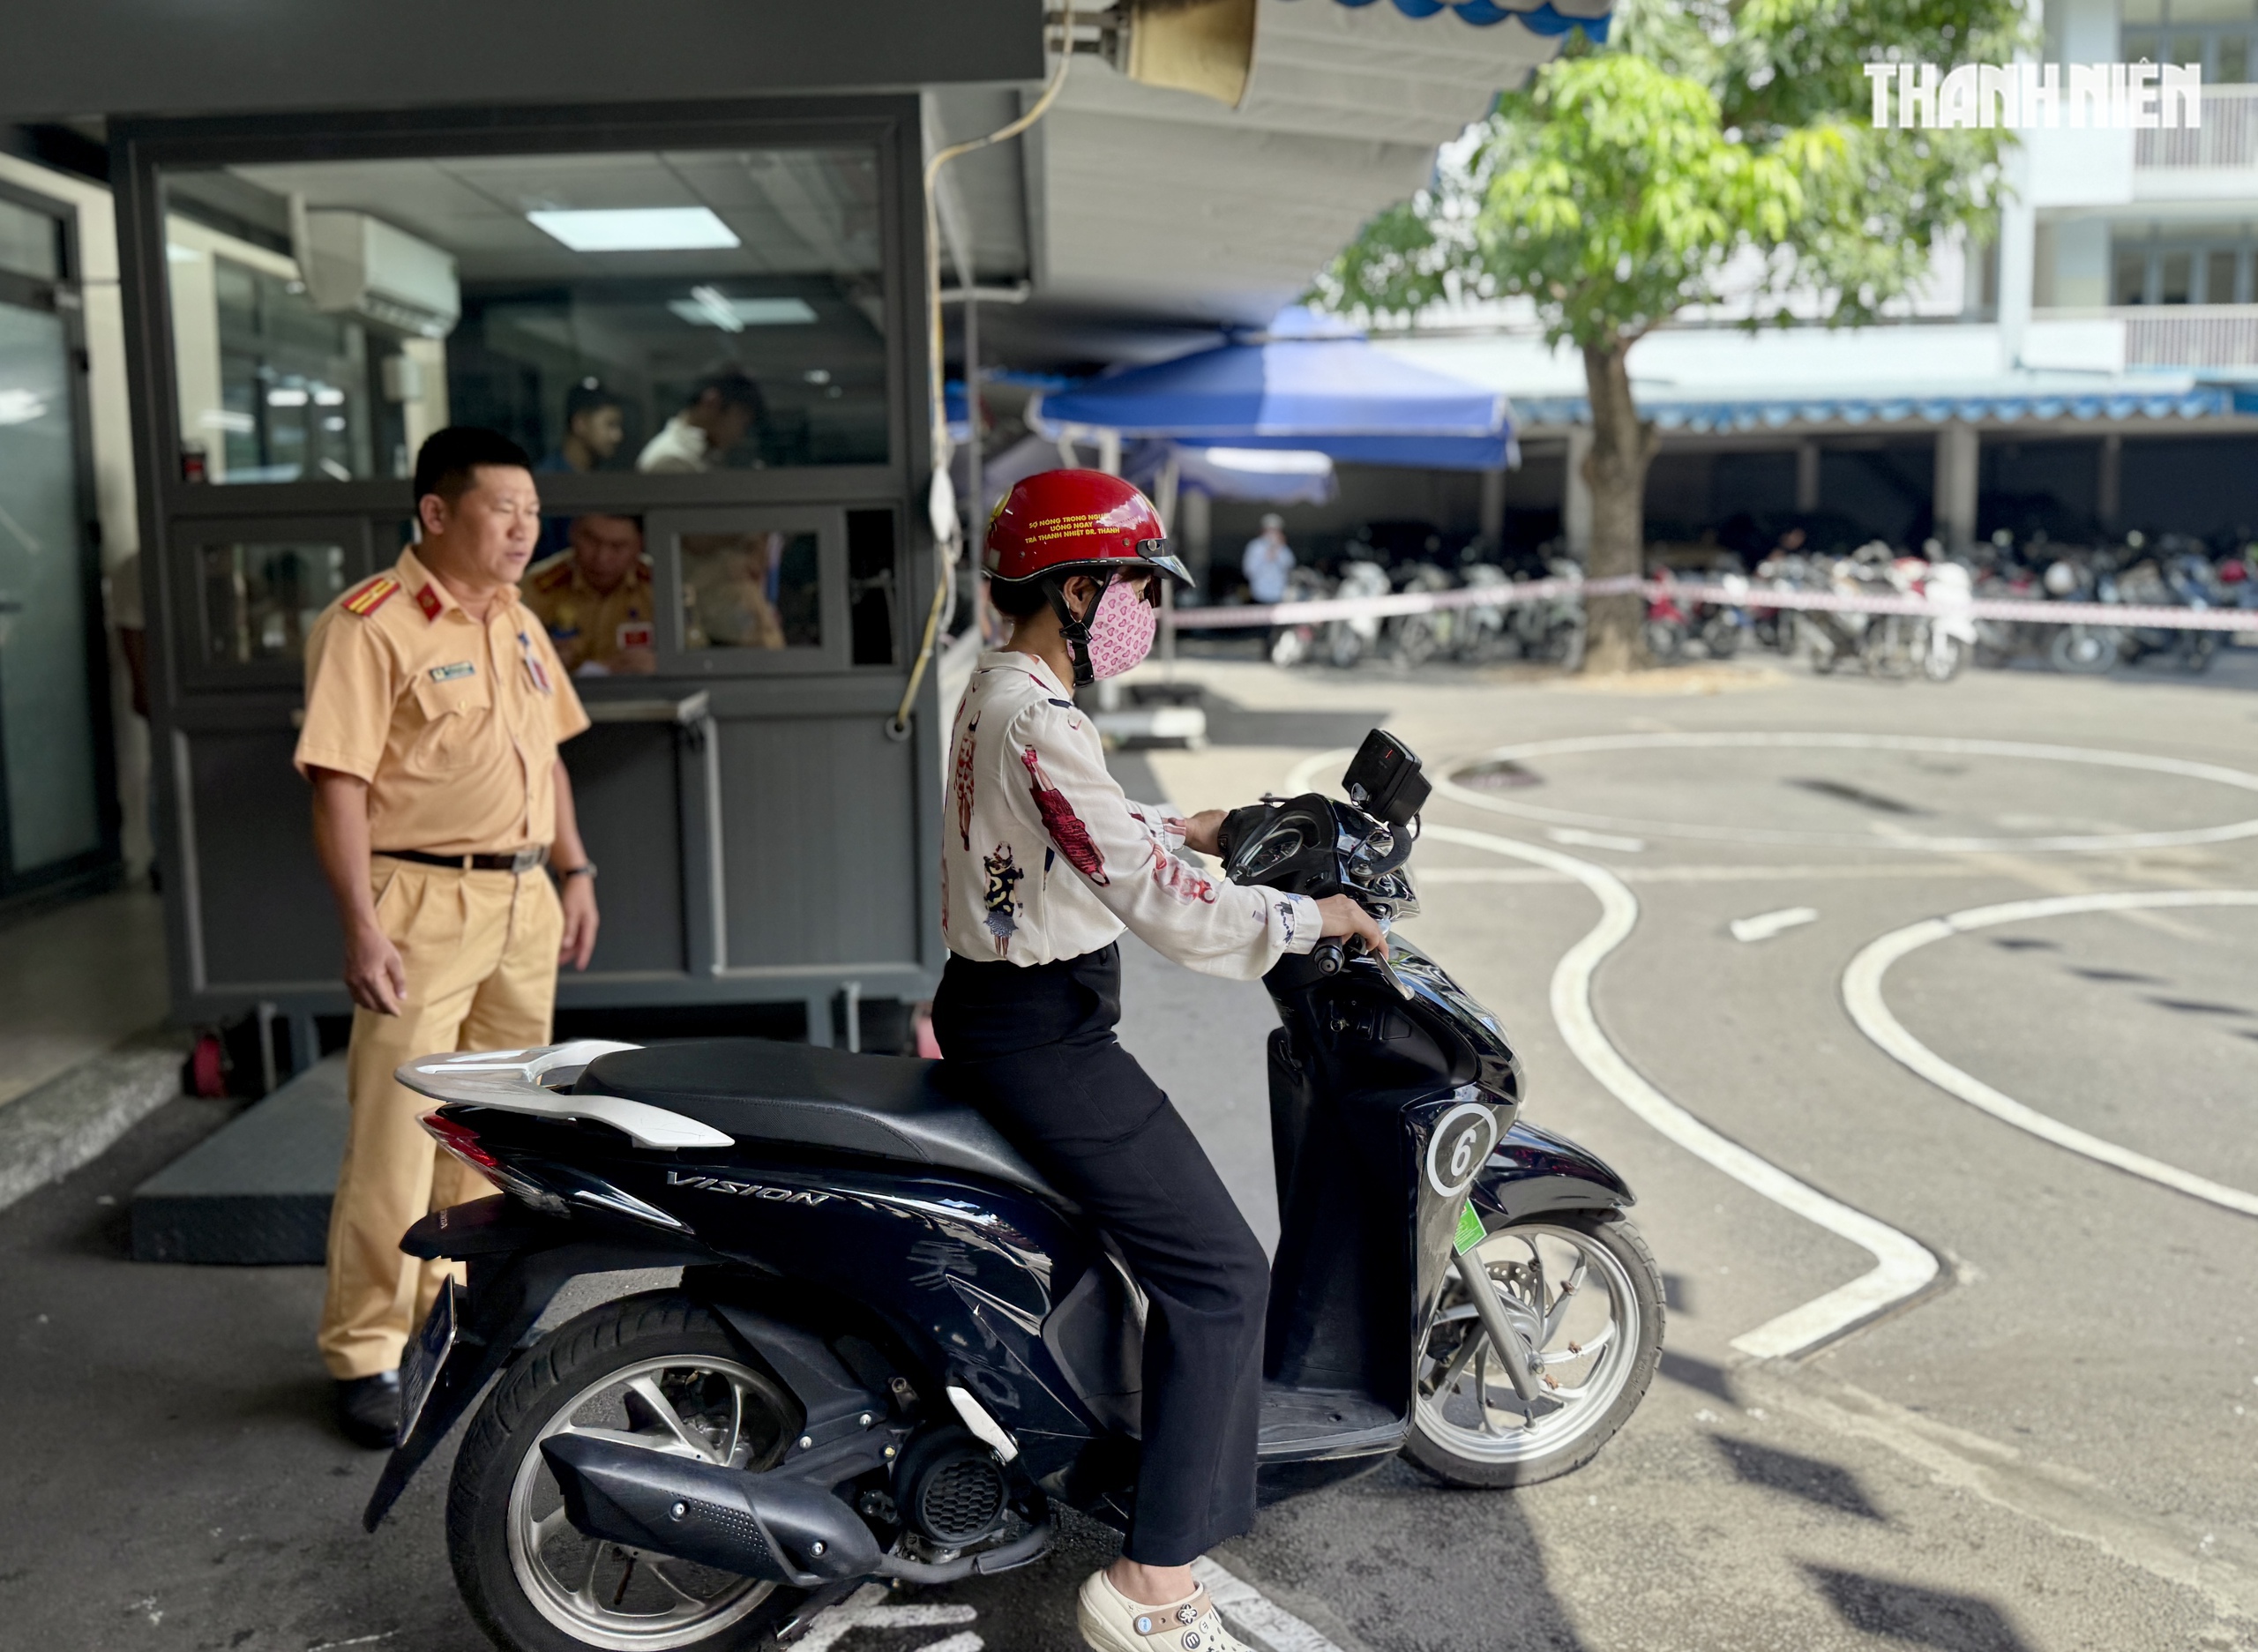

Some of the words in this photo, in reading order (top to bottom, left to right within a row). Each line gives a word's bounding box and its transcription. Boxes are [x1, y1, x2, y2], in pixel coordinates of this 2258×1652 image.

[1038, 532, 1063, 541] THANH
[1451, 1128, 1477, 1177] 6
[667, 1171, 830, 1207] VISION
